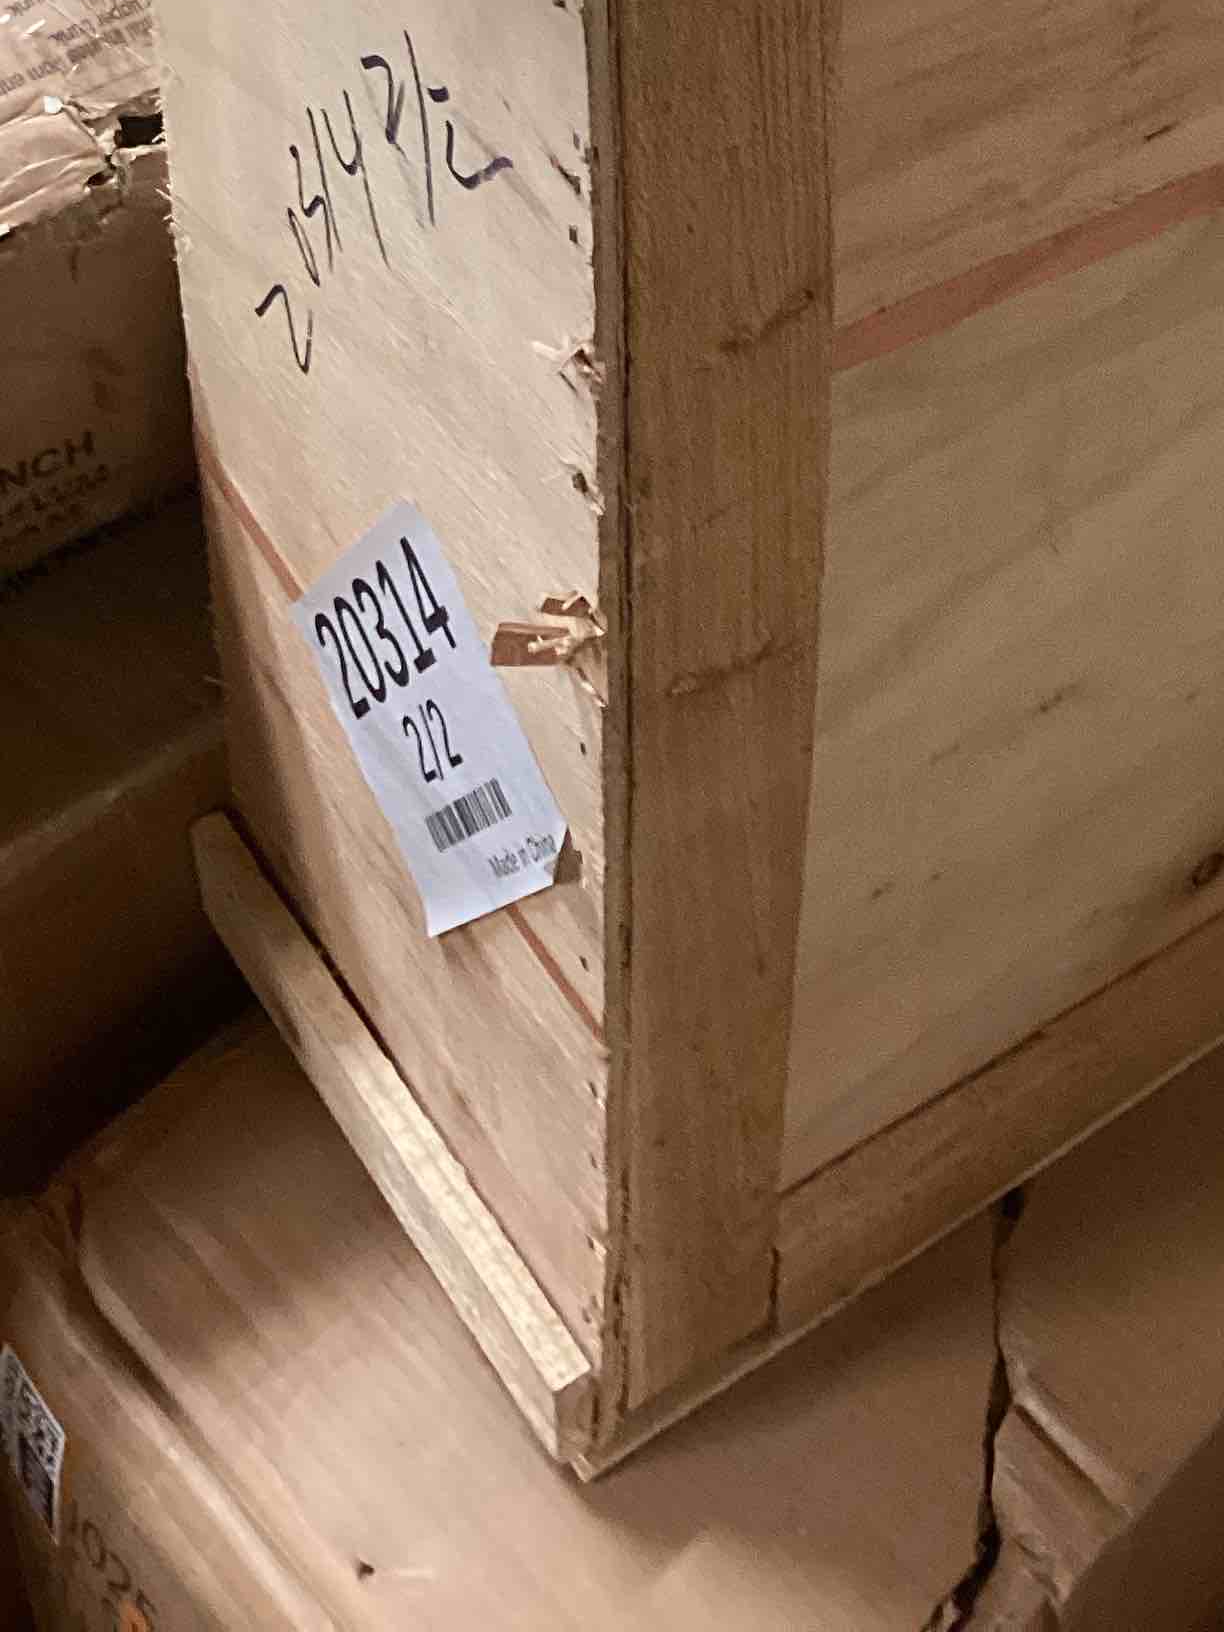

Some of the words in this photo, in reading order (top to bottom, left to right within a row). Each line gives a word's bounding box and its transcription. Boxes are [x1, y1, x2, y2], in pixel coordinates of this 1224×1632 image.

[314, 536, 457, 720] 20314
[402, 699, 463, 783] 2/2
[489, 847, 520, 877] Made
[526, 833, 557, 863] China
